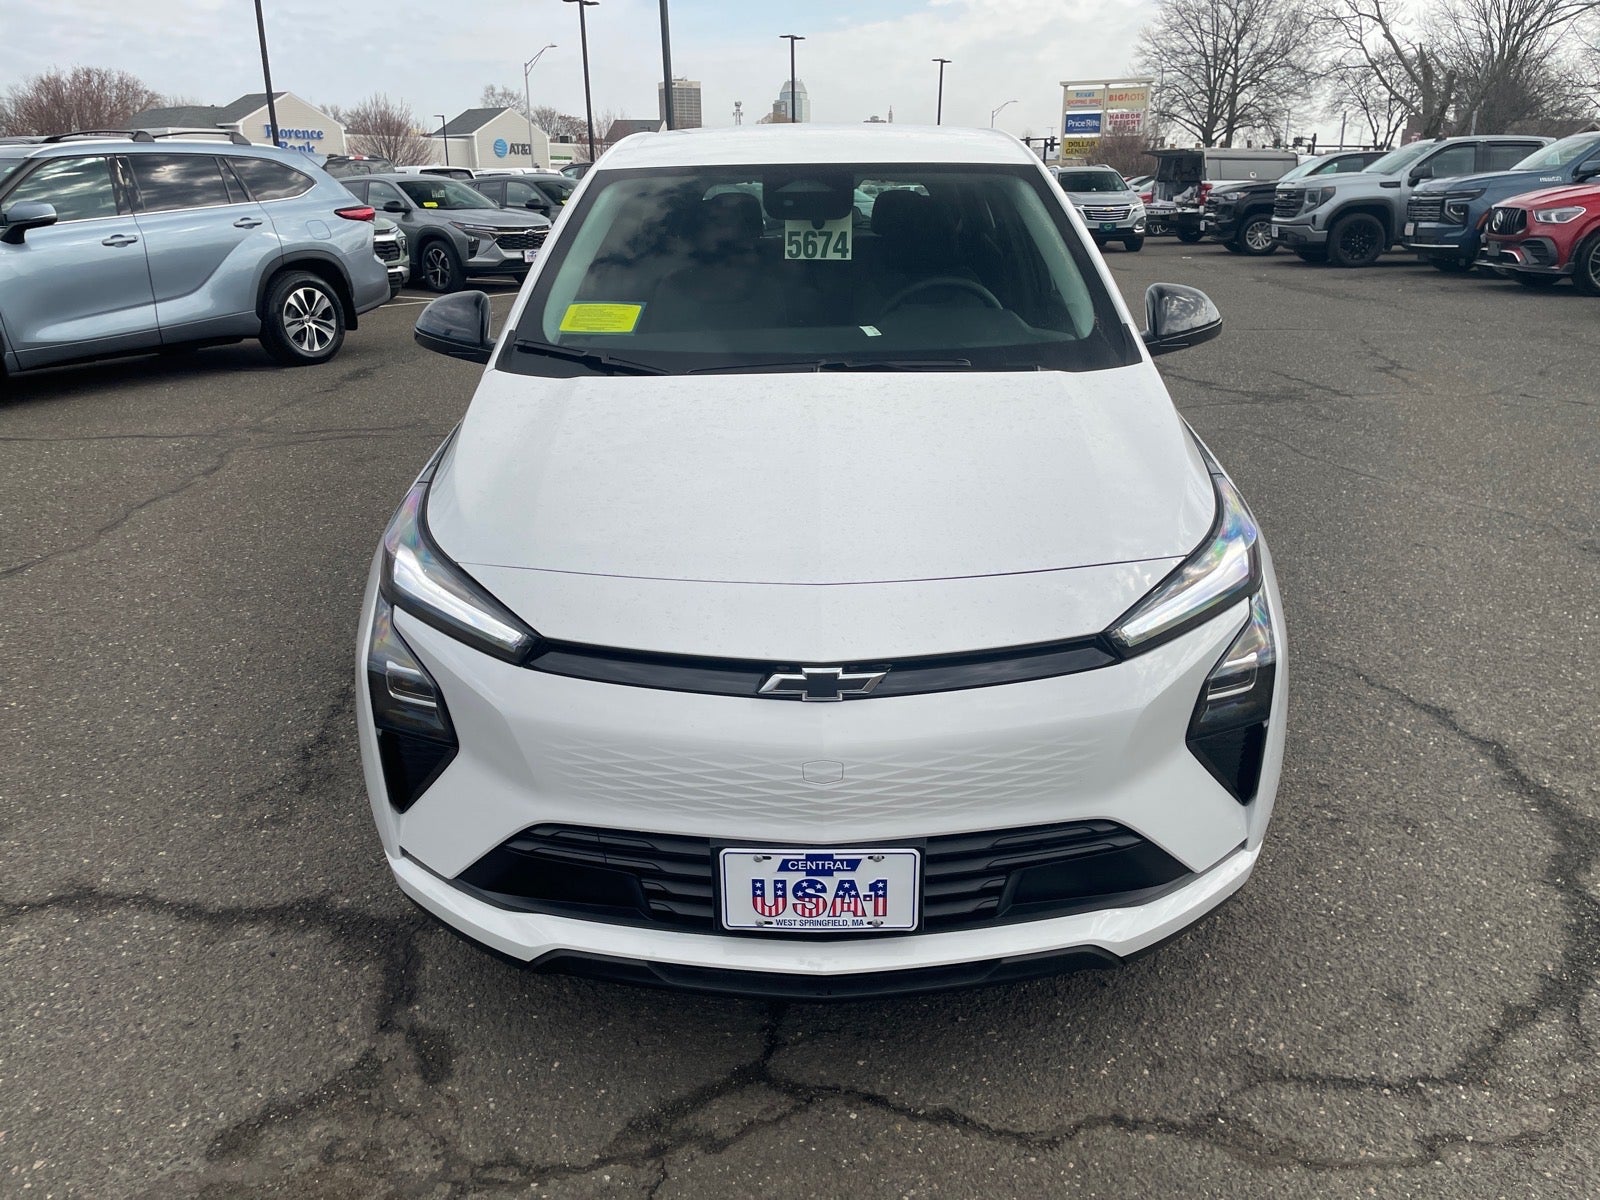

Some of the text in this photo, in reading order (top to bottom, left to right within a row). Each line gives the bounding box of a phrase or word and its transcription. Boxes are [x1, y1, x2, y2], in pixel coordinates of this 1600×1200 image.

[787, 230, 849, 258] 5674
[788, 860, 852, 870] CENTRAL
[751, 878, 888, 918] USA-1
[776, 918, 798, 926] WEST
[798, 919, 850, 928] SPRINGFIELD,
